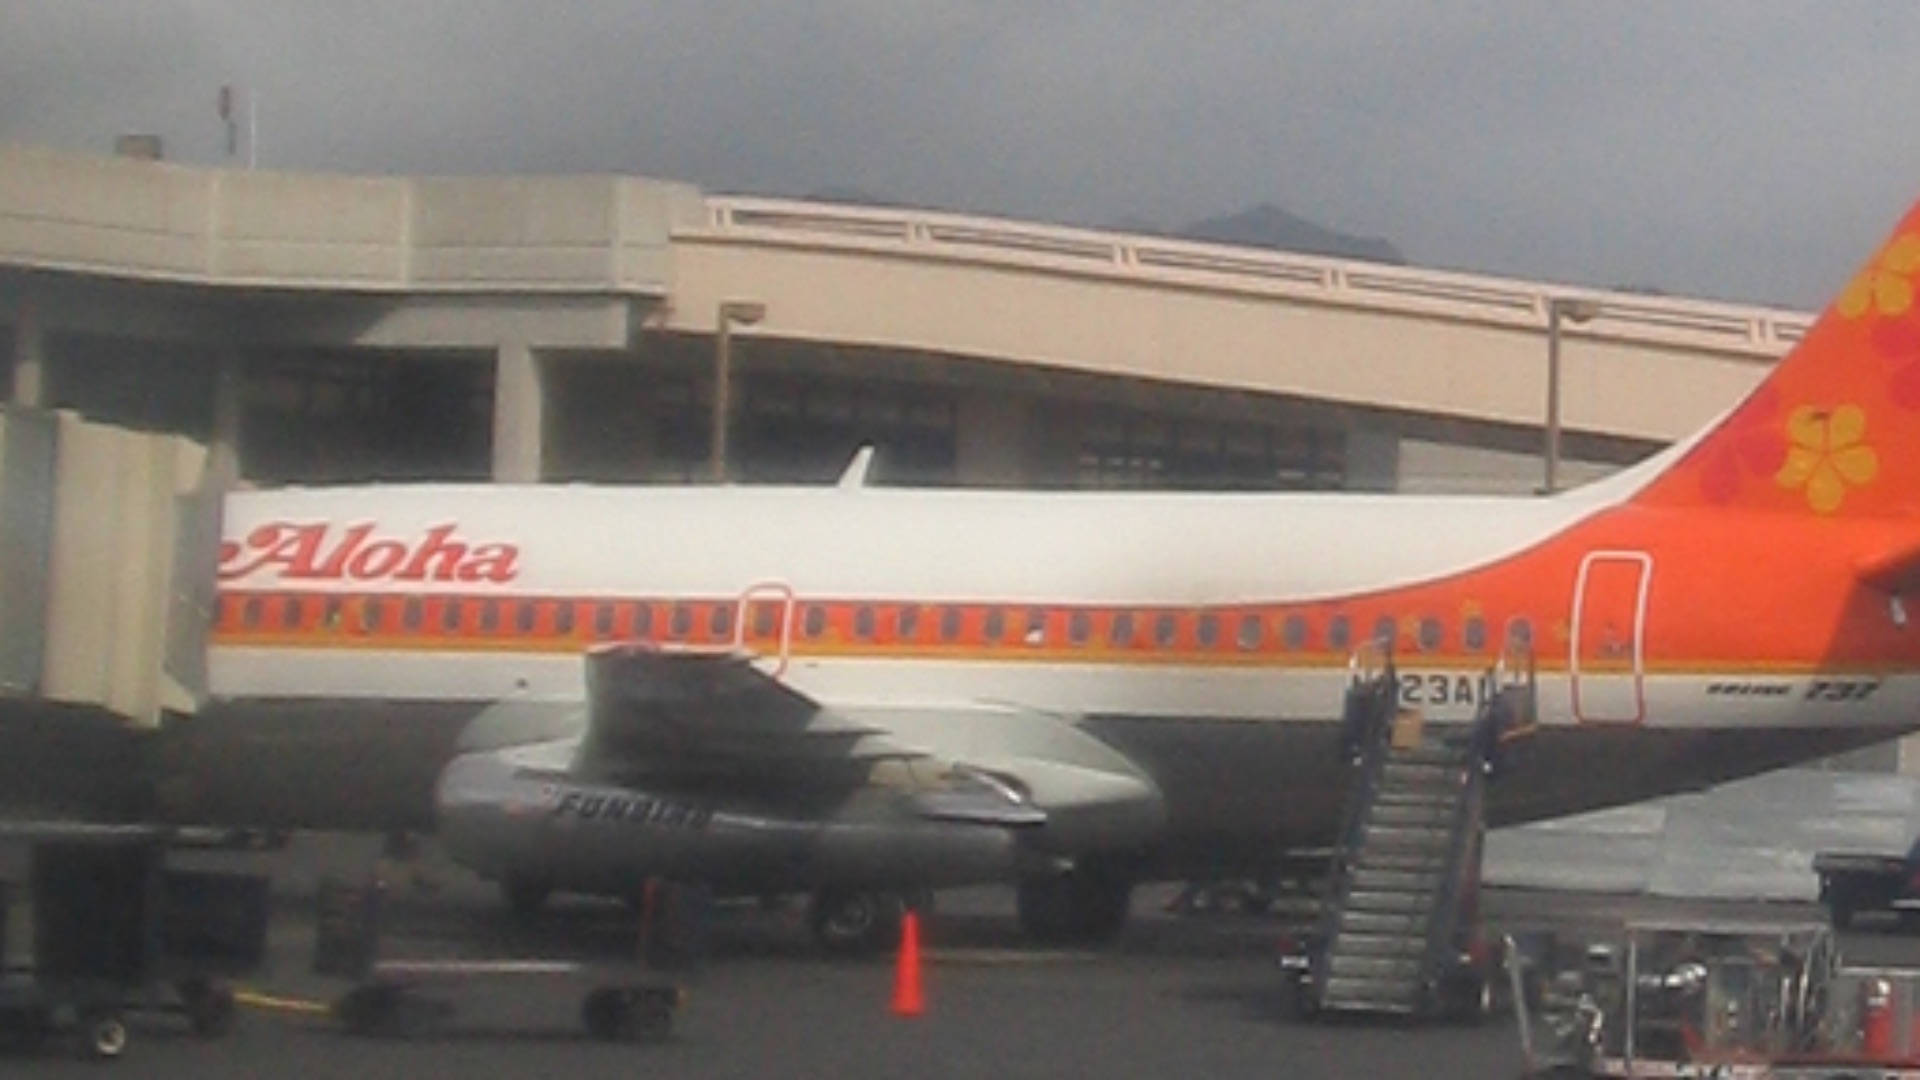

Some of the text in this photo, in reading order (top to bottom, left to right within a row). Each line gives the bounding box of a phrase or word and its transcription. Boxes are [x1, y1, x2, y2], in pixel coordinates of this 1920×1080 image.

[217, 520, 519, 583] Aloha
[1353, 673, 1493, 704] 23AL
[1804, 680, 1880, 701] 737
